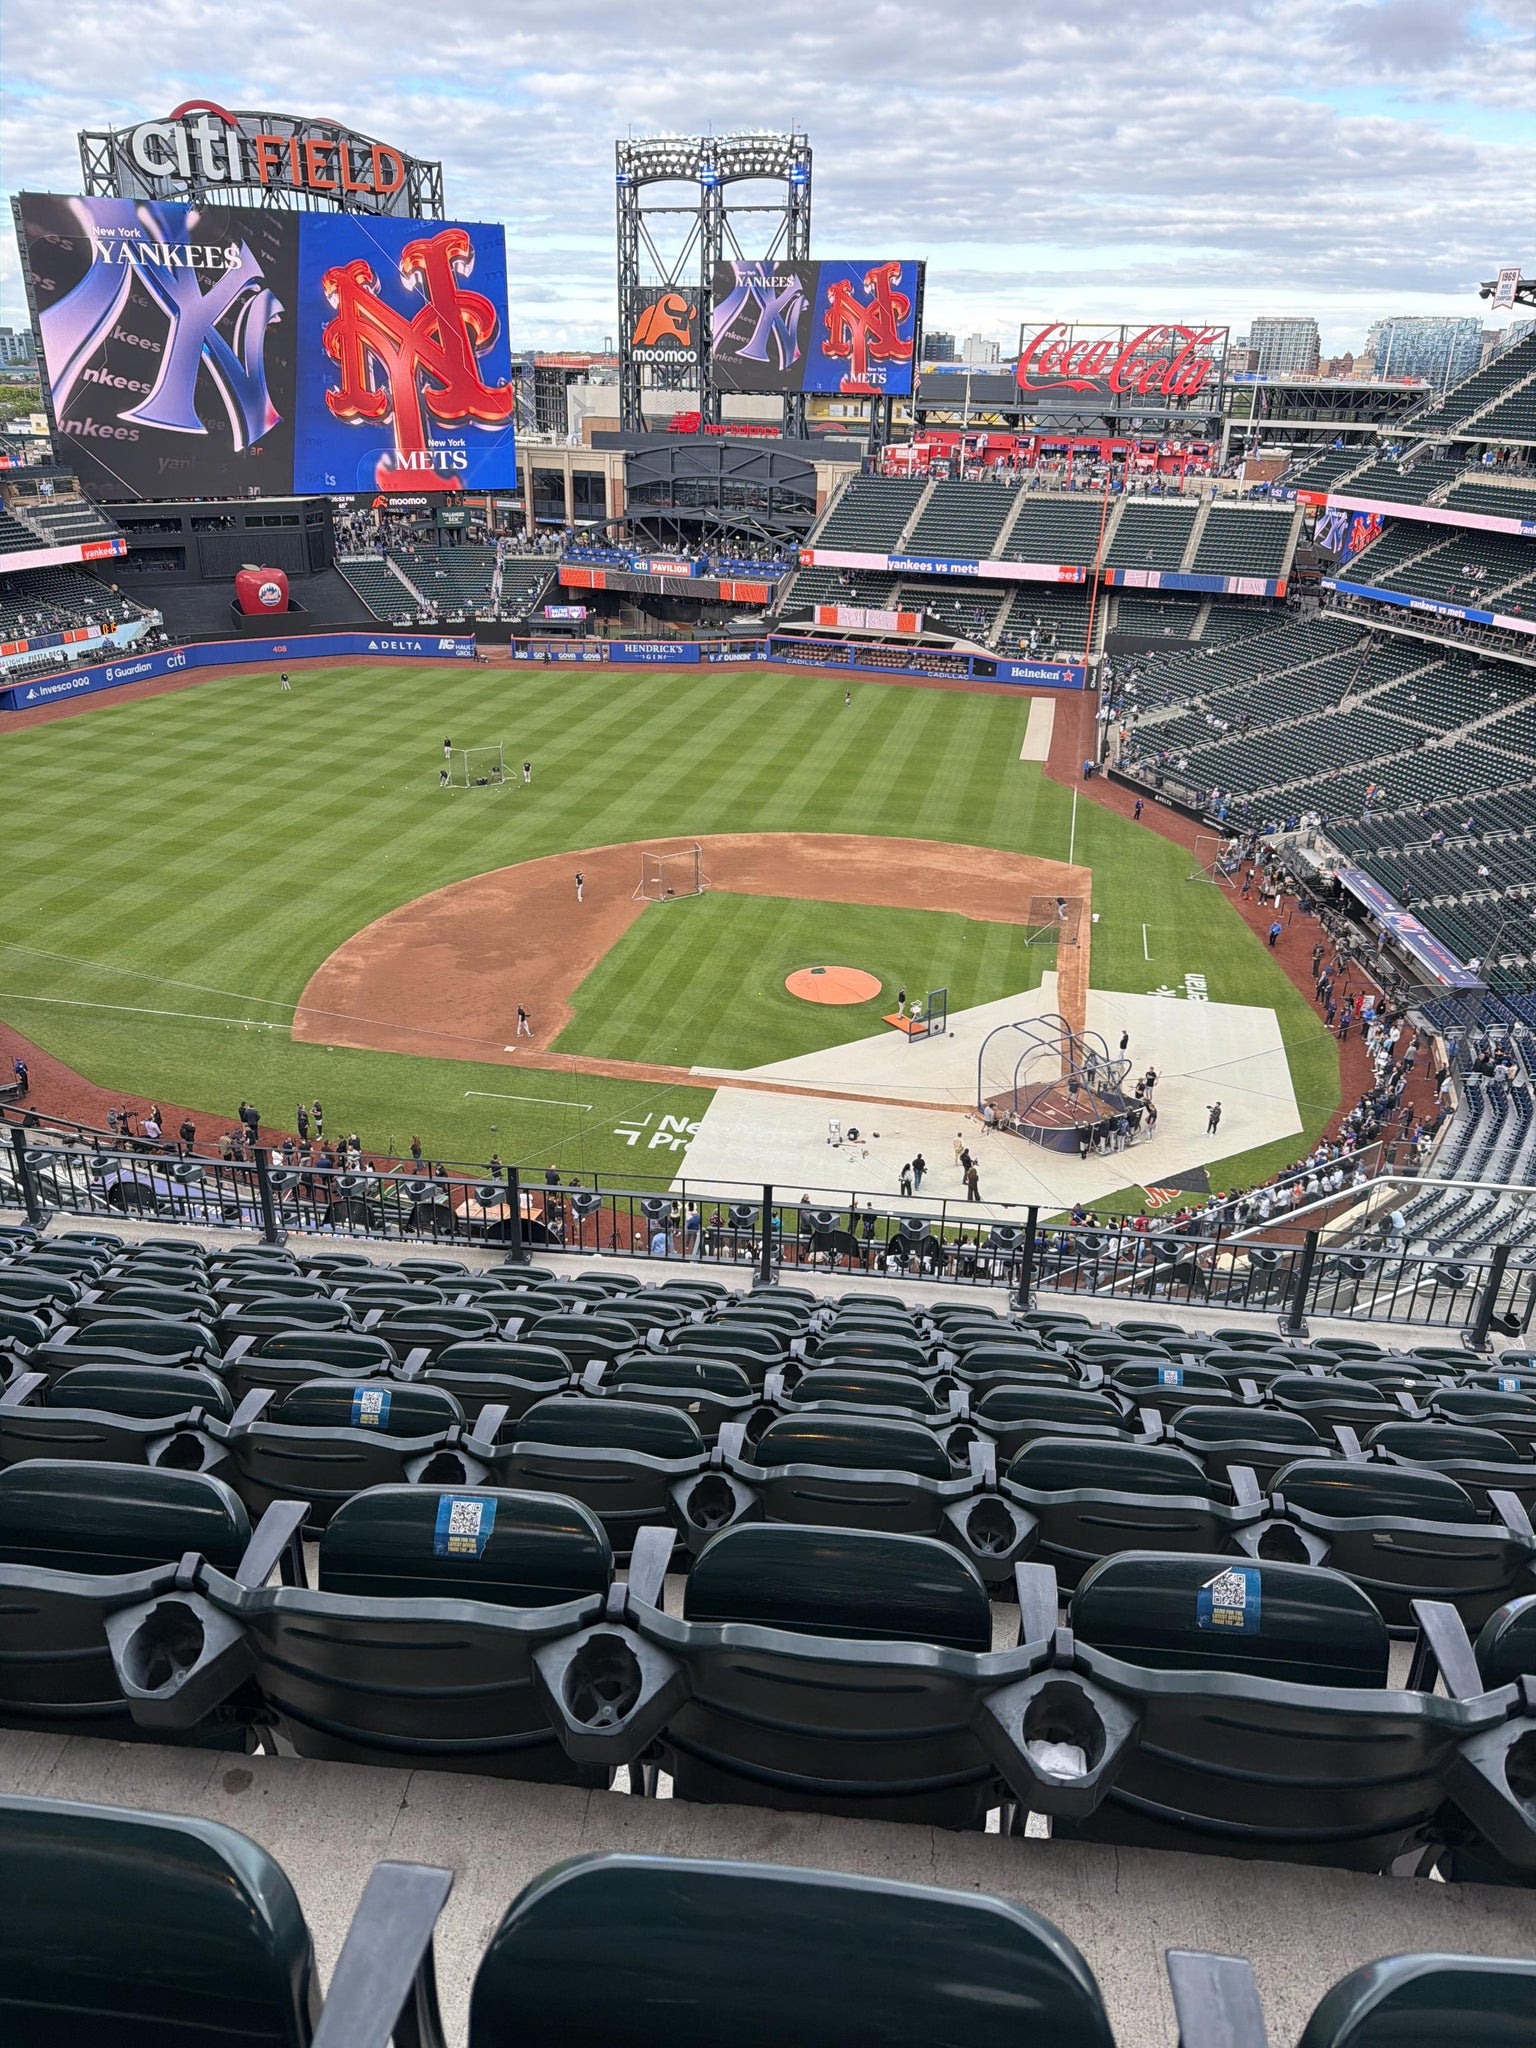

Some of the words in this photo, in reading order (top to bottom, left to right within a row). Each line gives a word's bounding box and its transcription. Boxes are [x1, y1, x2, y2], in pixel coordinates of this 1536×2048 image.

[132, 114, 242, 182] citi
[255, 134, 405, 193] FIELD
[92, 225, 115, 237] New
[117, 227, 141, 238] York
[95, 240, 243, 270] YANKEES
[736, 275, 795, 288] YANKEES
[1502, 272, 1517, 281] 1969
[109, 325, 162, 353] kees
[633, 350, 697, 363] moomoo
[850, 373, 887, 384] METS
[703, 424, 727, 434] new
[730, 422, 780, 436] balance
[428, 438, 446, 447] New
[447, 438, 466, 447] York
[395, 451, 468, 470] METS
[389, 497, 427, 505] moomoo
[84, 546, 117, 559] yankees
[634, 560, 648, 570] citi
[652, 563, 688, 574] PAVILION
[888, 559, 933, 572] yankees
[935, 562, 948, 572] vs
[950, 562, 979, 575] mets
[1321, 580, 1336, 589] mets
[1410, 600, 1438, 612] yankees
[1438, 606, 1447, 615] vs
[1447, 608, 1466, 618] mets
[273, 645, 287, 653] 408
[381, 640, 422, 651] DELTA
[624, 644, 683, 654] HENDRICK'S
[28, 653, 48, 661] FIESTA
[166, 653, 187, 668] citi
[515, 651, 528, 659] 380
[786, 658, 826, 667] CADILLAC
[114, 662, 152, 678] Guardian
[927, 671, 970, 680] CADILLAC
[1011, 667, 1061, 680] Heineken
[40, 683, 72, 696] Invesco
[72, 676, 90, 688] QQQ
[648, 1132, 691, 1152] Pr
